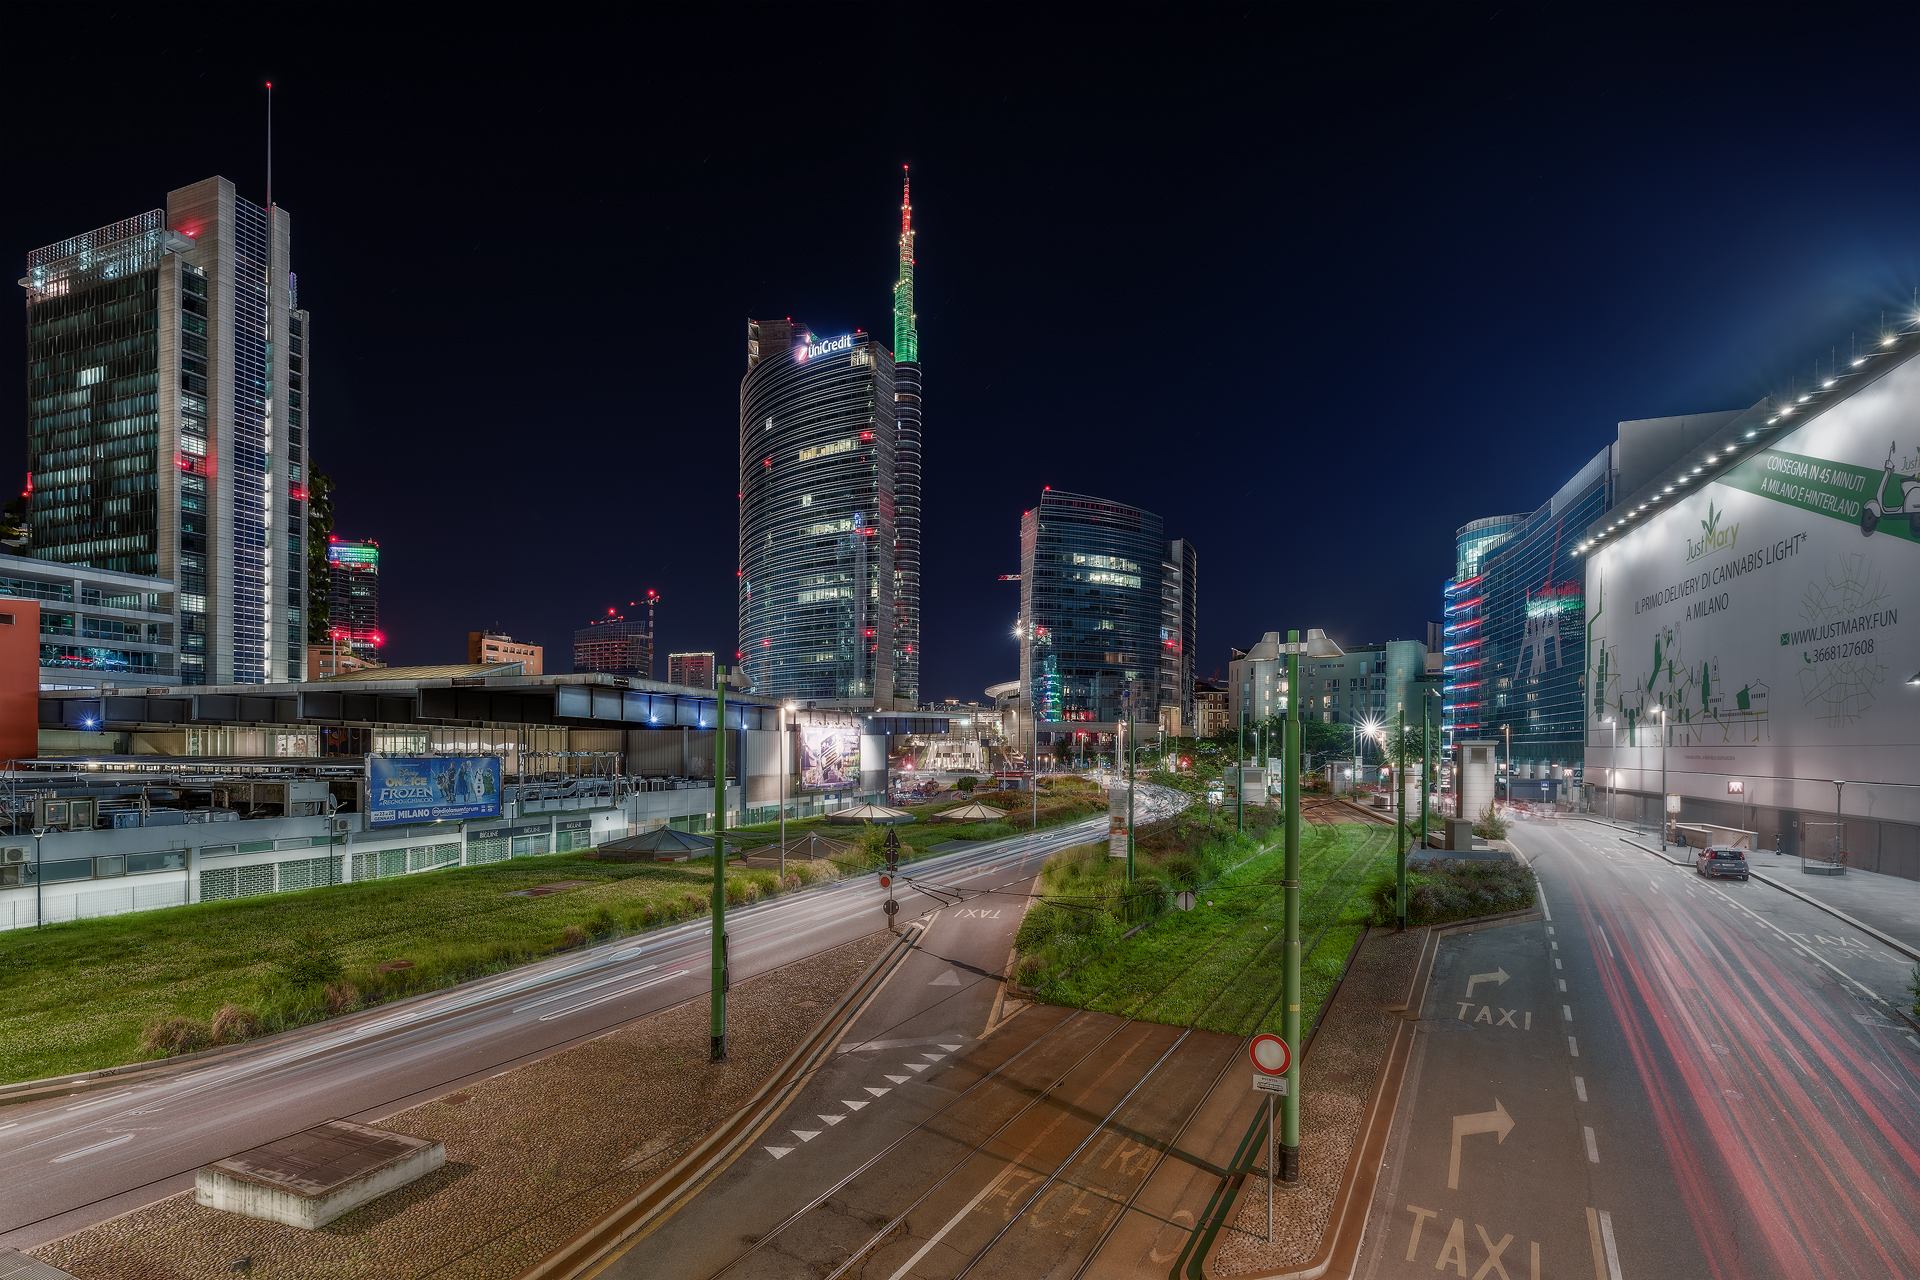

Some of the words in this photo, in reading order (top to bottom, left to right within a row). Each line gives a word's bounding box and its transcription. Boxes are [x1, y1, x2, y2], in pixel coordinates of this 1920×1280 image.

[808, 334, 851, 358] UniCredit
[1767, 455, 1808, 478] CONSEGNA
[1809, 465, 1820, 480] IN
[1819, 468, 1831, 484] 45
[1830, 470, 1866, 492] MINUTI
[1760, 478, 1768, 490] A
[1767, 479, 1798, 500] MILANO
[1798, 487, 1805, 501] E
[1804, 489, 1860, 517] HINTERLAND
[1634, 601, 1641, 615] IL
[1641, 591, 1663, 613] PRIMO
[1664, 576, 1700, 604] DELIVERY
[1701, 573, 1711, 590] DI
[1712, 549, 1763, 585] CANNABIS
[1685, 606, 1692, 622] A
[1693, 592, 1729, 619] MILANO
[1790, 608, 1898, 645] WWW.JUSTMARY.FUN
[1813, 638, 1874, 663] 3668127608
[379, 786, 434, 801] FROZEN
[385, 777, 402, 787] ON
[411, 777, 427, 786] ICE
[398, 809, 430, 819] MILANO
[953, 909, 1001, 919] TAXI
[1788, 932, 1870, 948] TAXI
[1457, 1001, 1532, 1031] TAXI
[1405, 1204, 1541, 1280] TAXI
